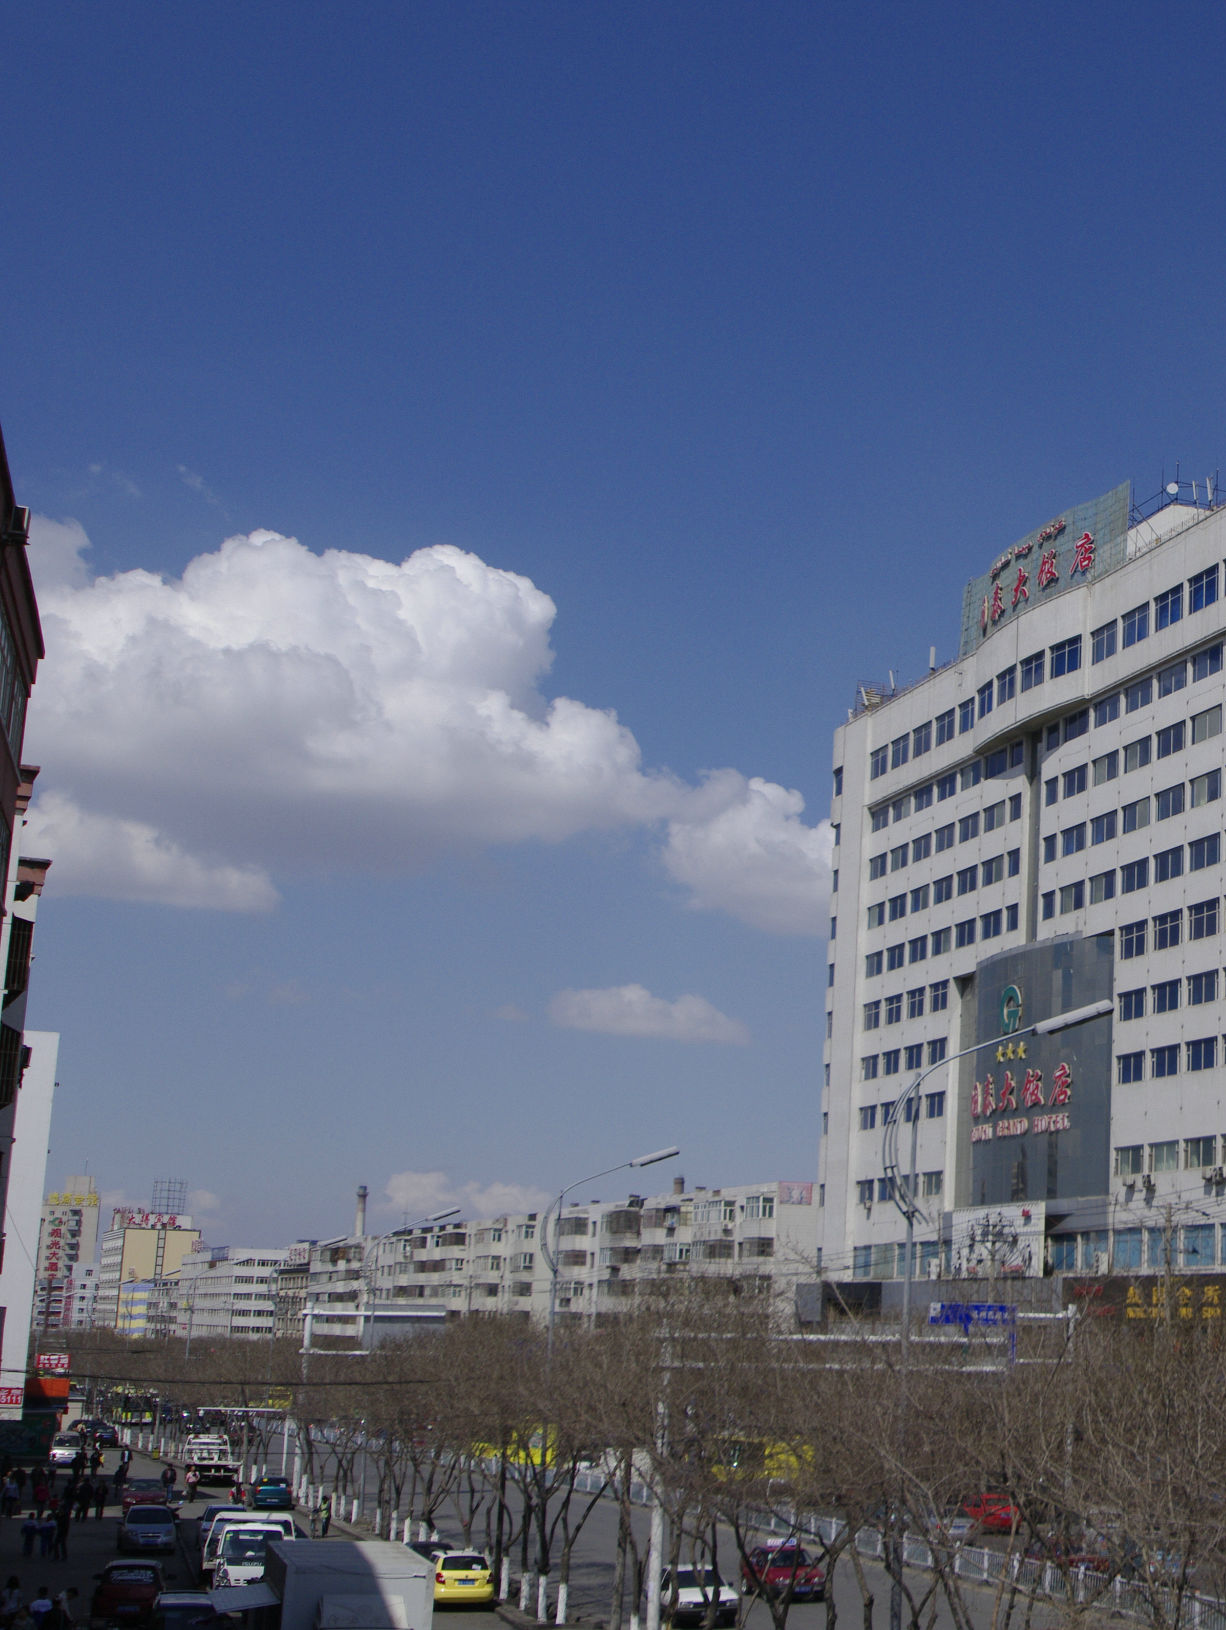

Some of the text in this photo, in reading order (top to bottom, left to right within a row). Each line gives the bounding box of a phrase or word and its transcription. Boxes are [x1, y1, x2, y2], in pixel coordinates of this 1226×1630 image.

[971, 1063, 1071, 1117] 国泰大饭店
[996, 1118, 1028, 1136] GRAND
[1033, 1113, 1071, 1133] HOTEL
